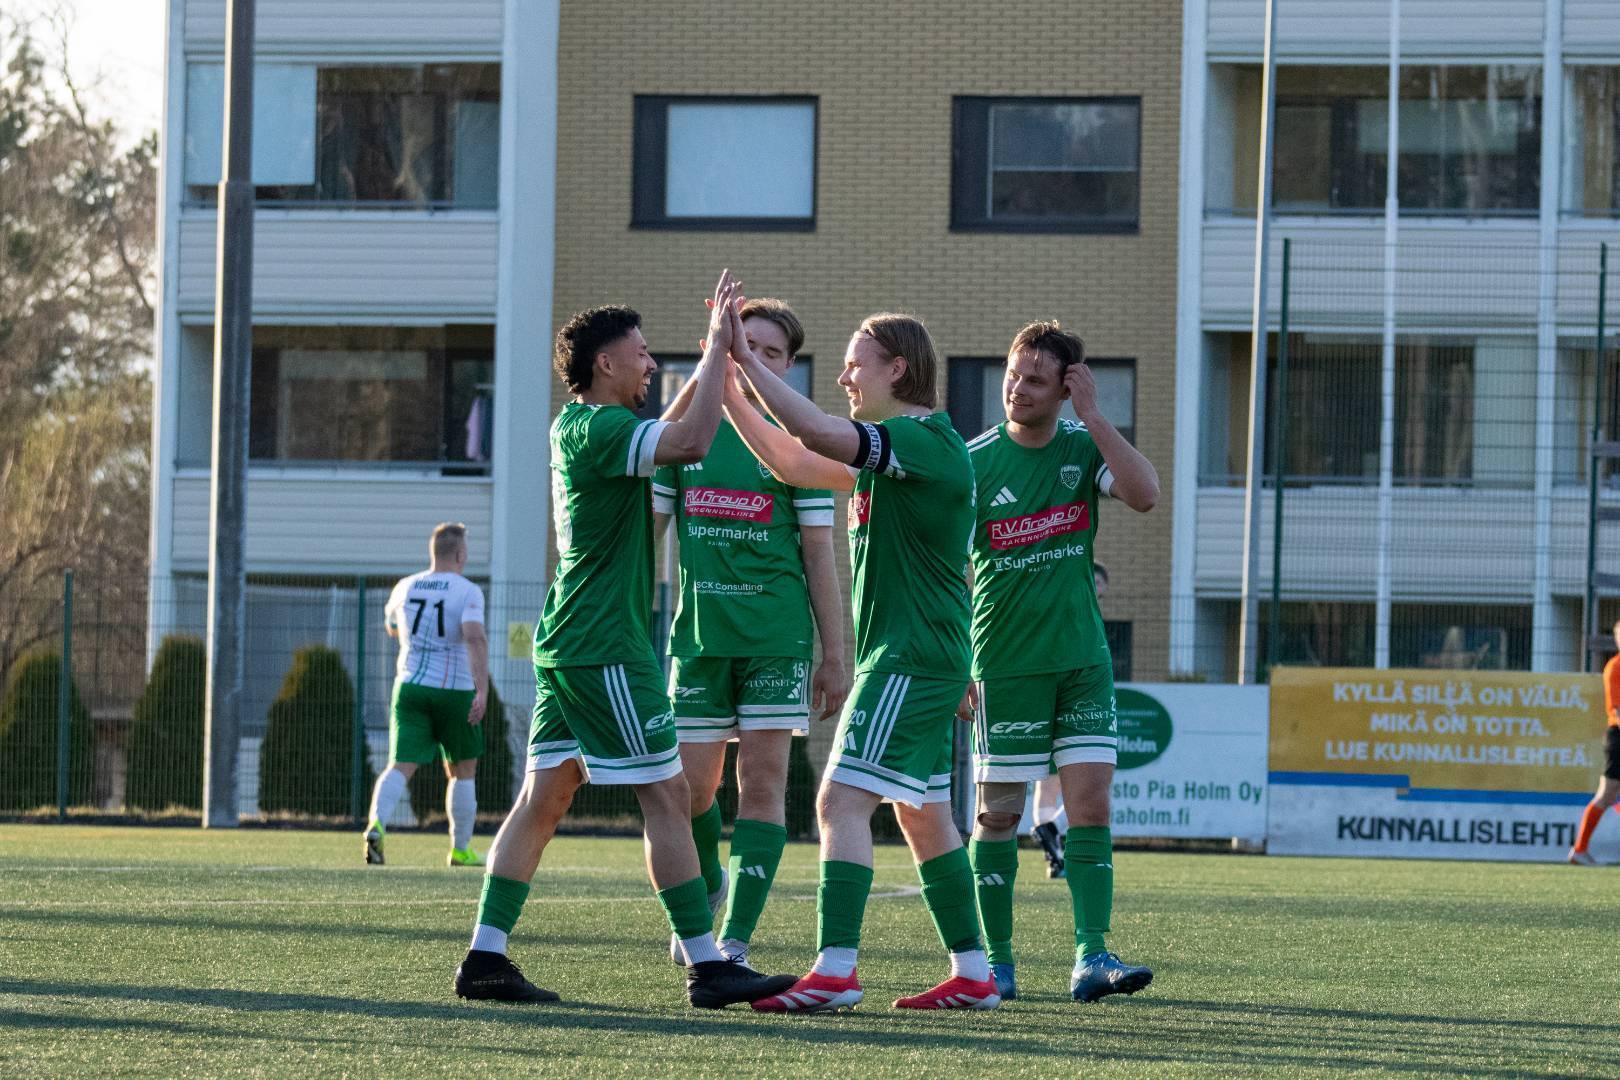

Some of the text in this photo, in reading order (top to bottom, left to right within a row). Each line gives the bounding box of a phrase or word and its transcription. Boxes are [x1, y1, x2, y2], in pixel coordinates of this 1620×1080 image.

[715, 583, 763, 593] Consulting
[409, 598, 445, 637] 71
[792, 663, 804, 679] 15
[1333, 680, 1406, 703] KYLLÄ
[1478, 687, 1513, 706] ON
[849, 709, 867, 726] 20
[989, 721, 1050, 734] EPF
[1370, 710, 1551, 737] MIKÄ ON TOTTA.
[1325, 740, 1368, 760] LUE
[1147, 780, 1176, 799] Pia
[1184, 781, 1231, 800] Holm
[1238, 782, 1263, 804] Oy
